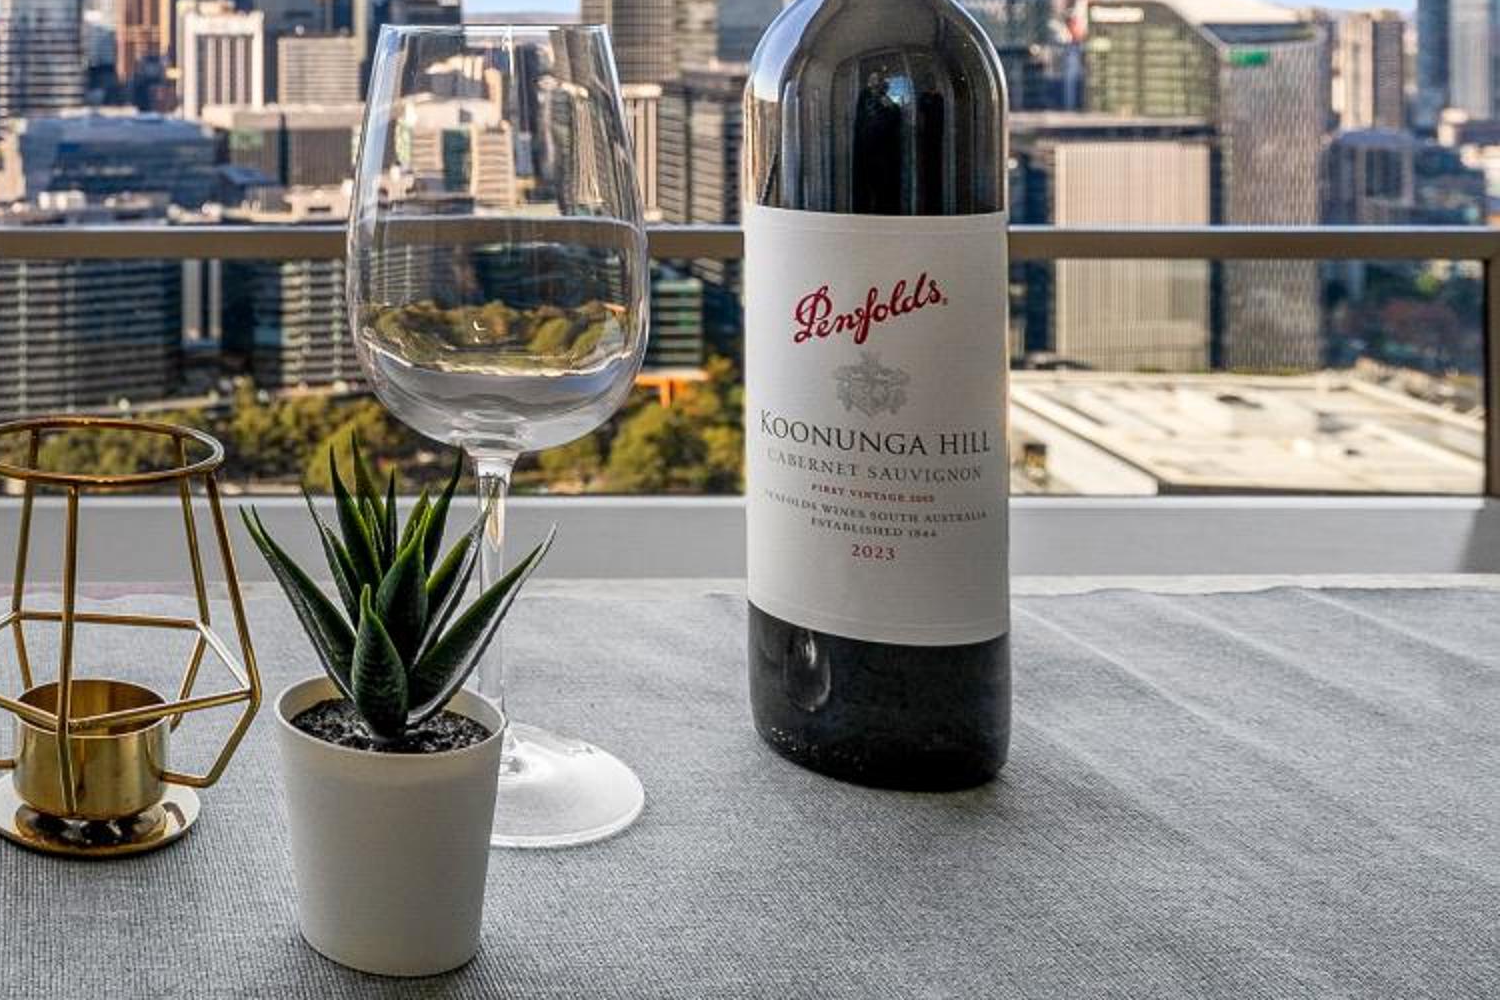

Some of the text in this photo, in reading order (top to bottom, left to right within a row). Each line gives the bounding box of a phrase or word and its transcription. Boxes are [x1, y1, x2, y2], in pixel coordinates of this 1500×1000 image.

[794, 272, 942, 345] Penfolds
[761, 409, 991, 456] KOONUNGA HILL
[766, 447, 982, 483] CABERNET SAUVIGNON
[810, 516, 904, 537] ESTABLISHED
[868, 509, 919, 523] SOUTH
[850, 542, 896, 561] 2023
